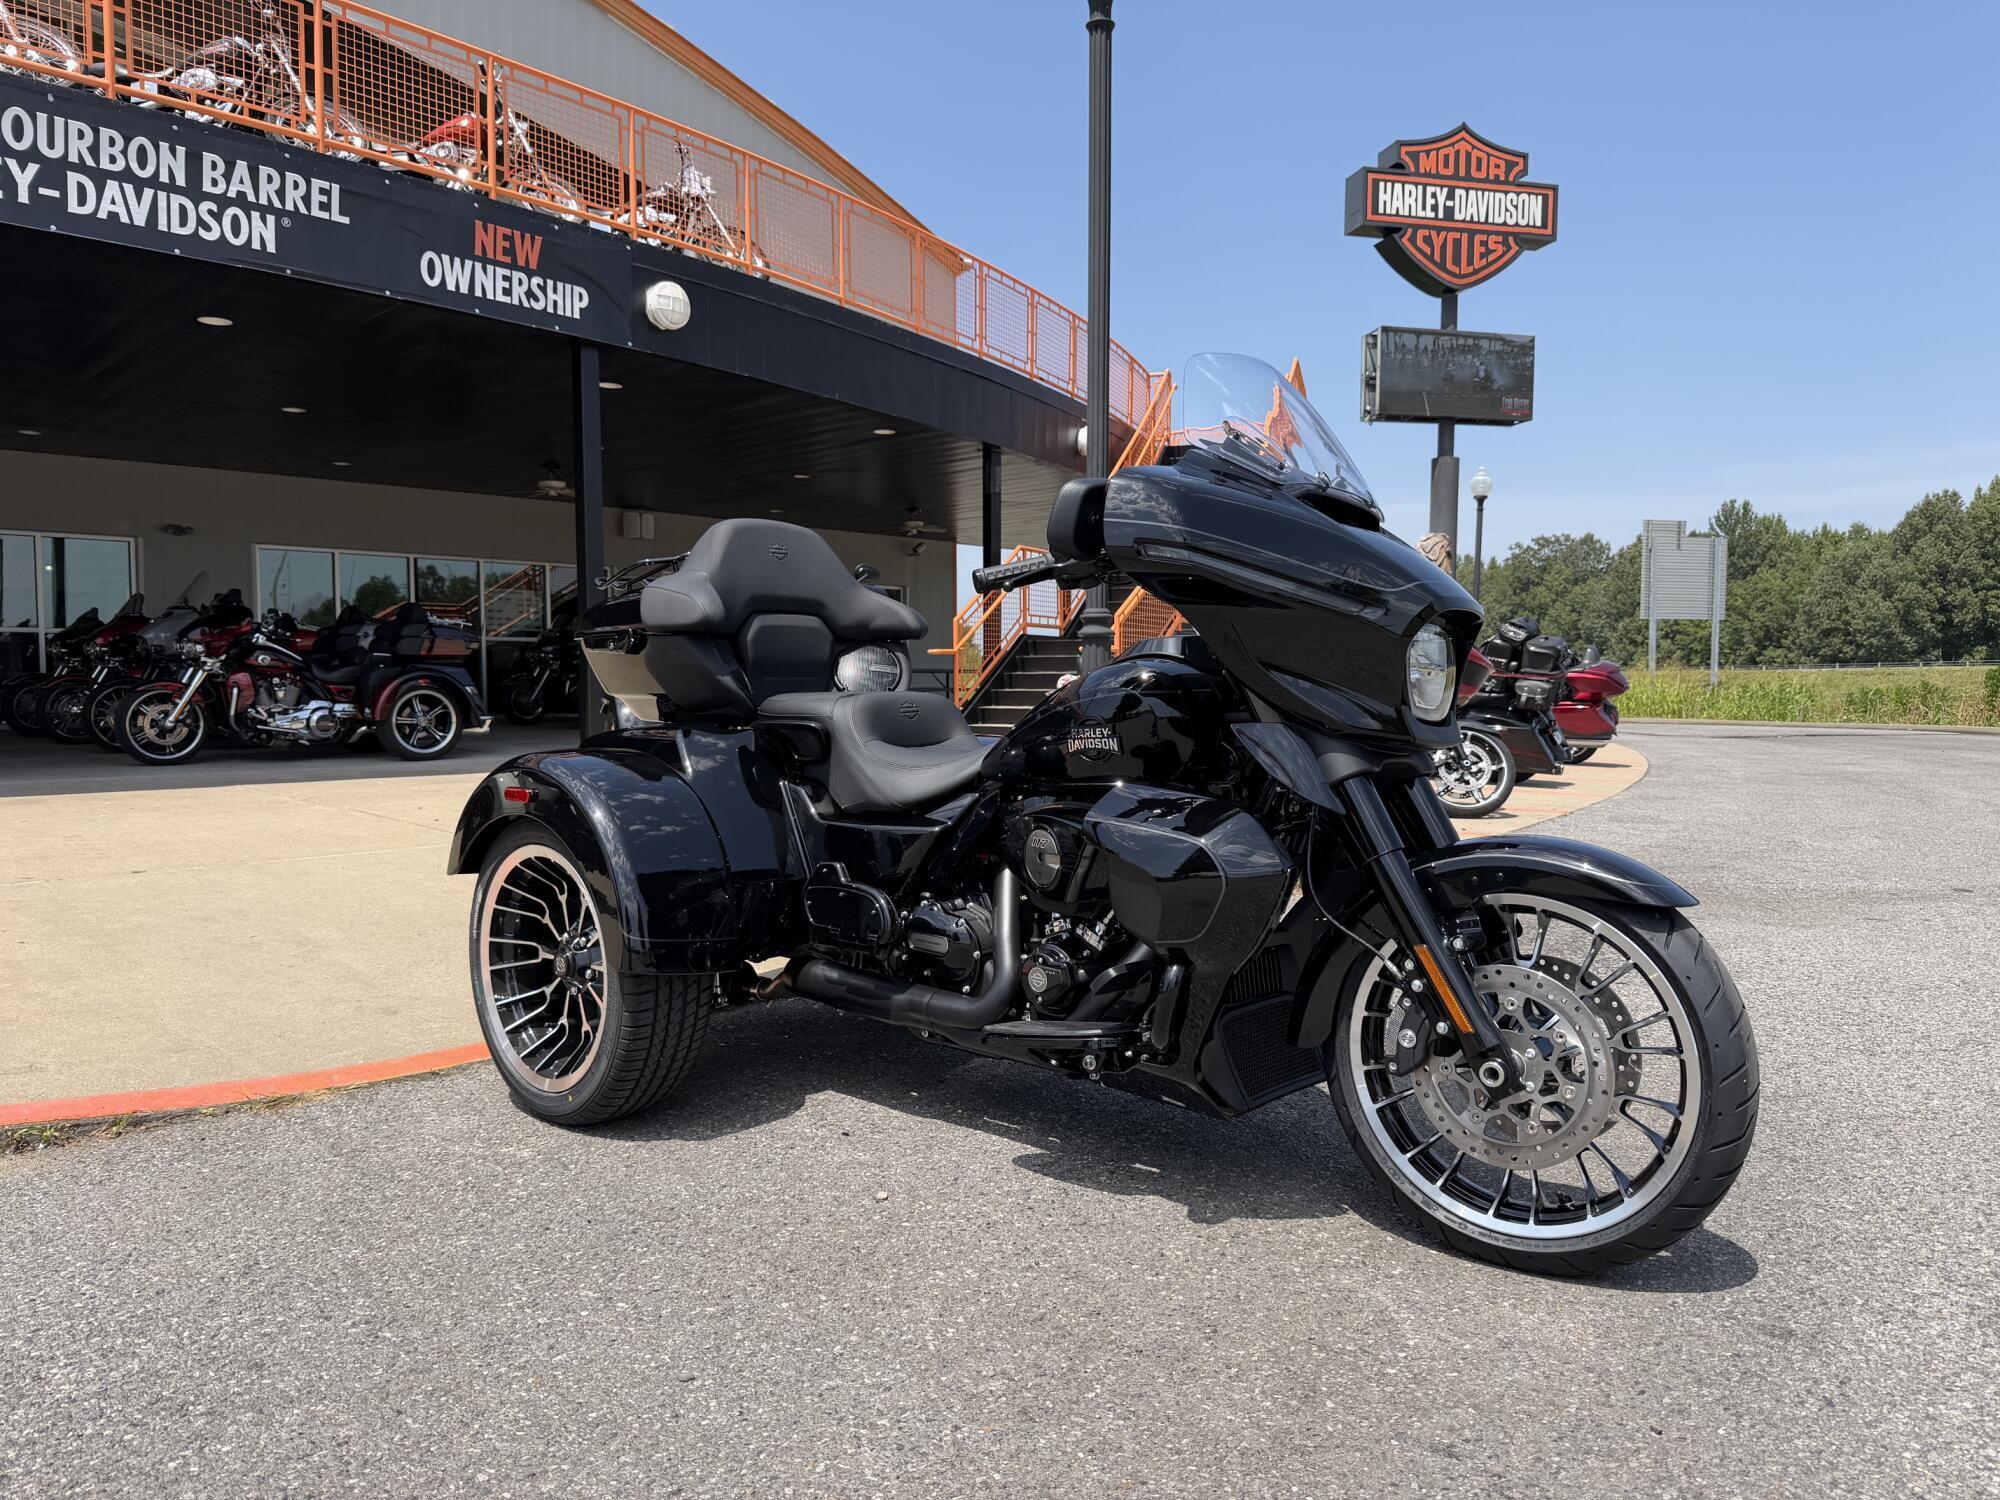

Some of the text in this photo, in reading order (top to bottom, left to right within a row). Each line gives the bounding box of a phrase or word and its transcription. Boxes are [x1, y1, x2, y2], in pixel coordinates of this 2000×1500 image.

[1419, 140, 1506, 181] MOTOR
[201, 151, 351, 225] BARREL
[1378, 181, 1543, 228] HARLEY-DAVIDSON
[474, 219, 543, 270] NEW
[1416, 229, 1504, 275] CYCLES
[419, 250, 590, 320] OWNERSHIP
[1067, 737, 1119, 753] DAVIDSON
